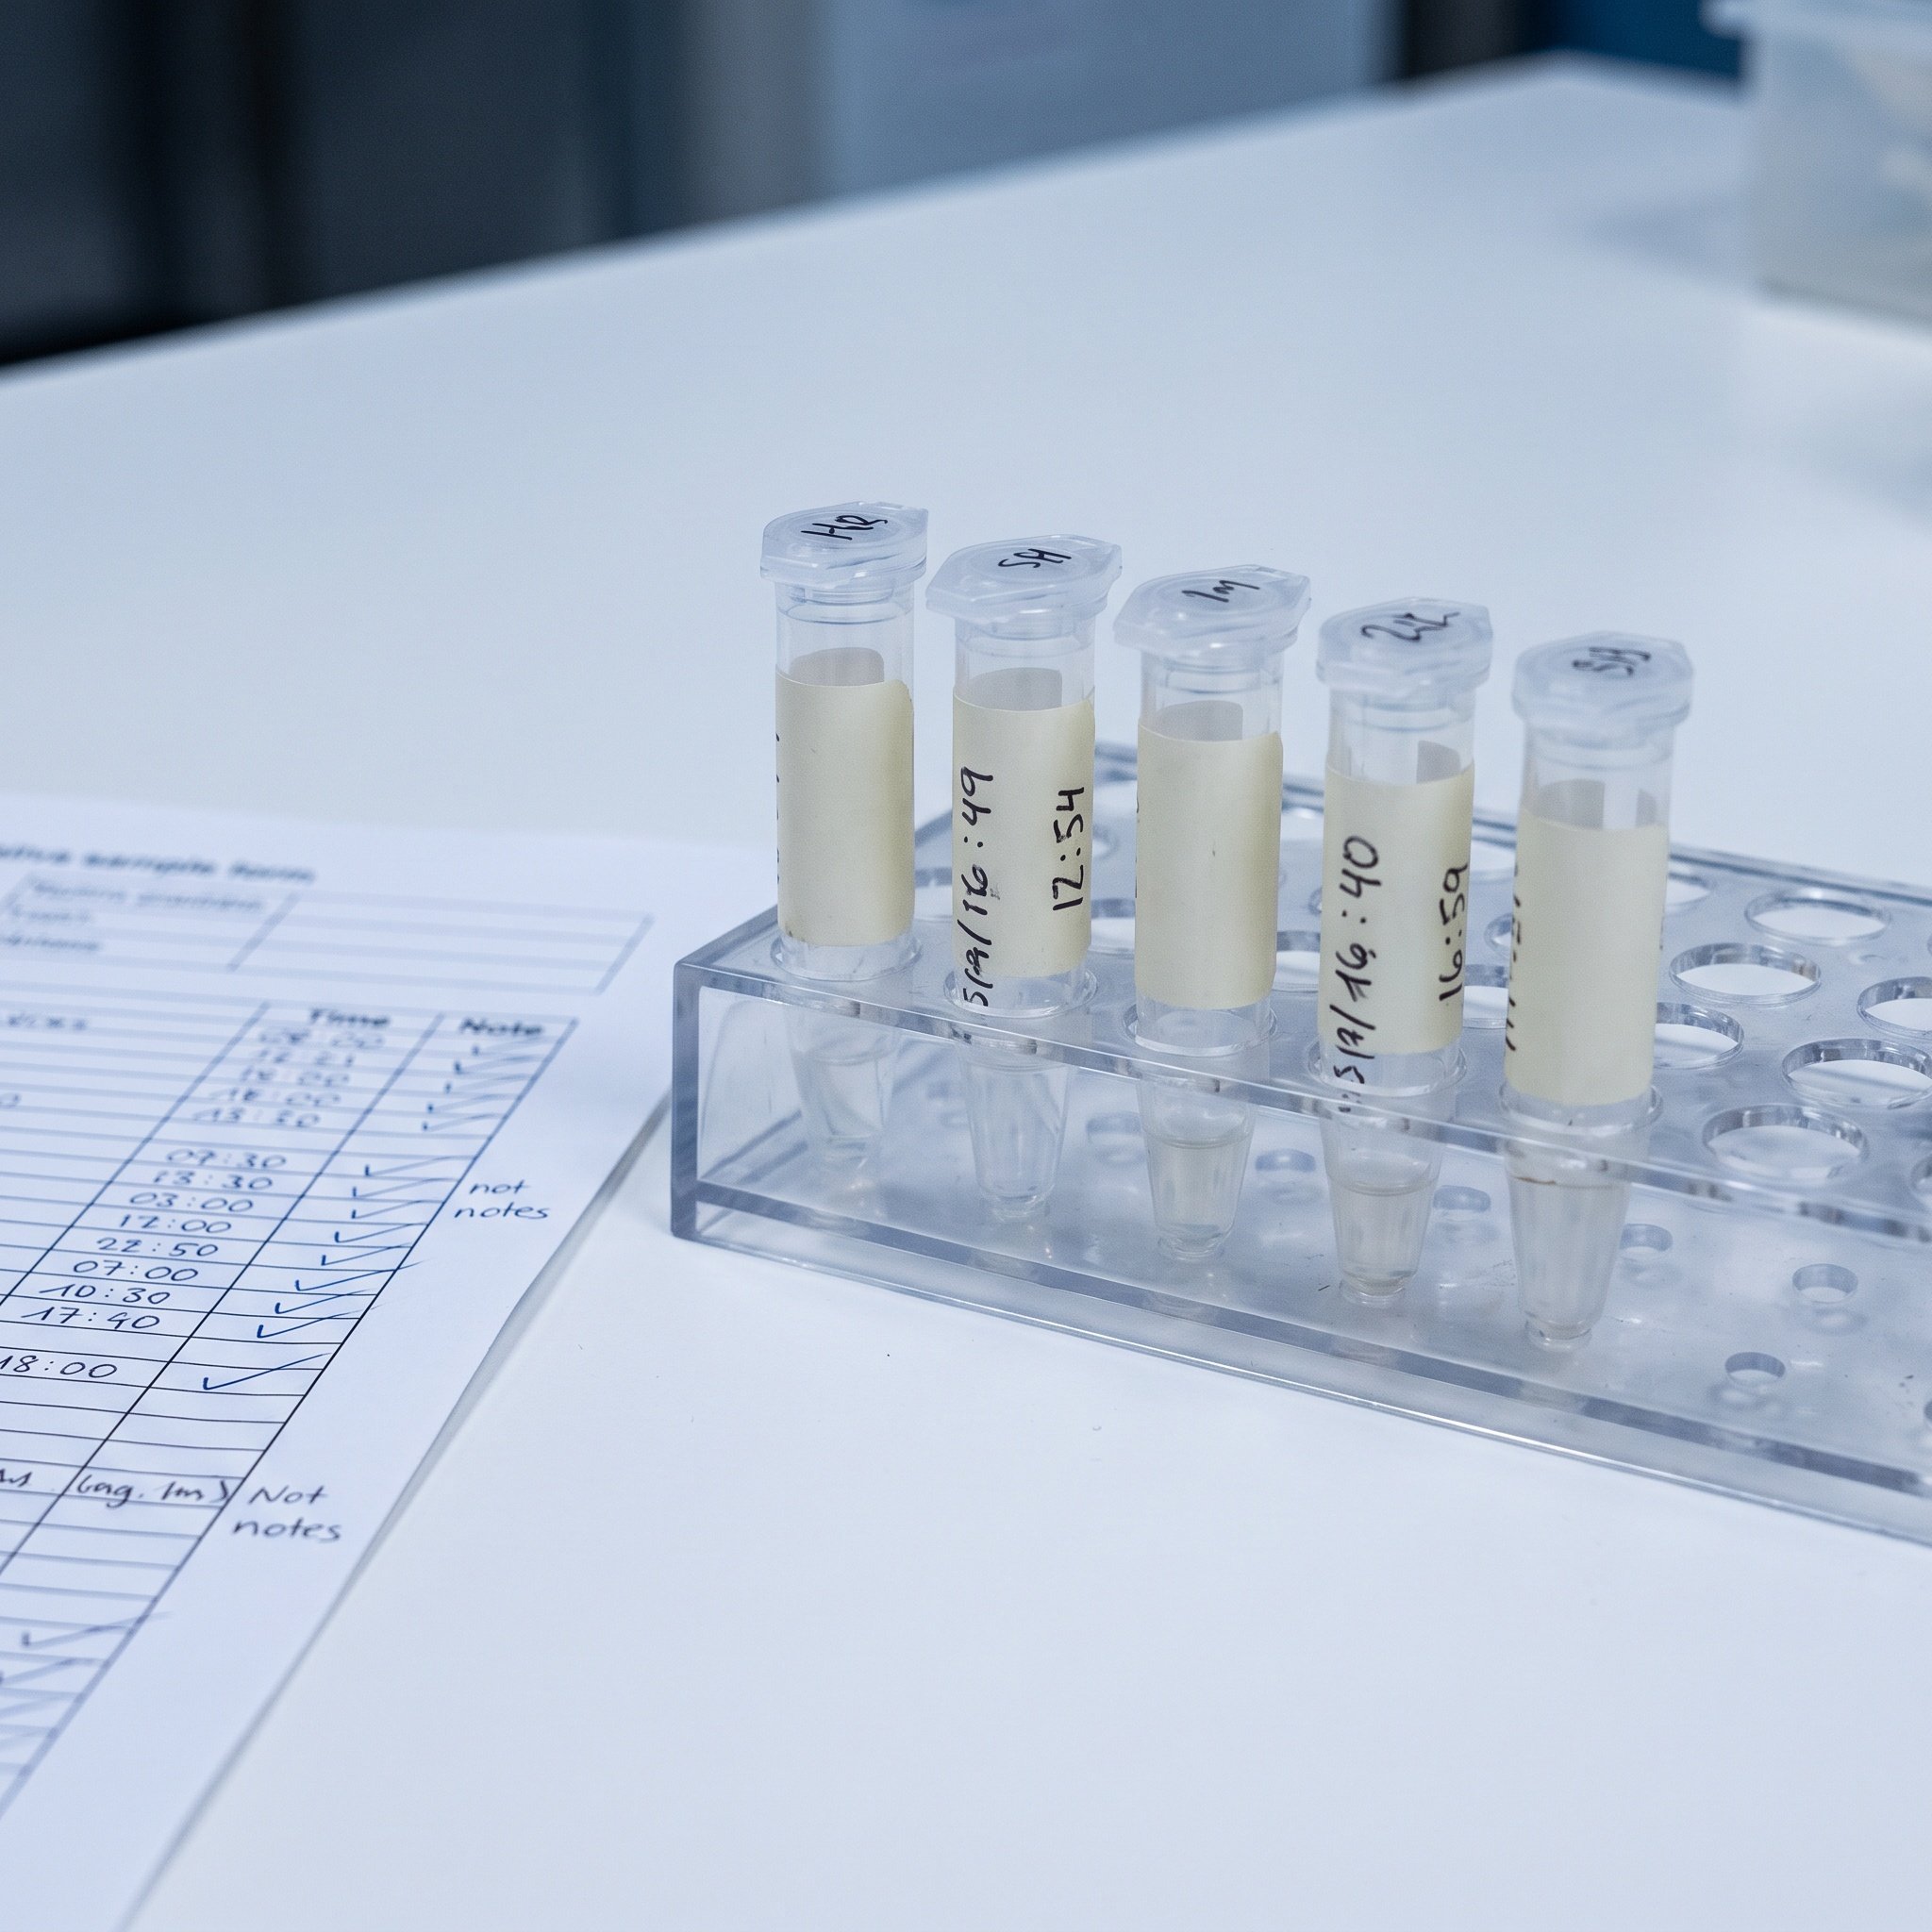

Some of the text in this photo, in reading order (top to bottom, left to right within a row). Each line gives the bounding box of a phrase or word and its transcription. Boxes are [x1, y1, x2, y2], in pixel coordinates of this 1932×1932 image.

[1052, 786, 1086, 912] 12:54
[469, 1179, 531, 1195] not
[128, 1191, 255, 1214] 03:00
[453, 1201, 550, 1220] notes
[72, 1259, 200, 1283] 07:00
[38, 1283, 172, 1307] 10:30
[233, 1517, 342, 1541] notes
